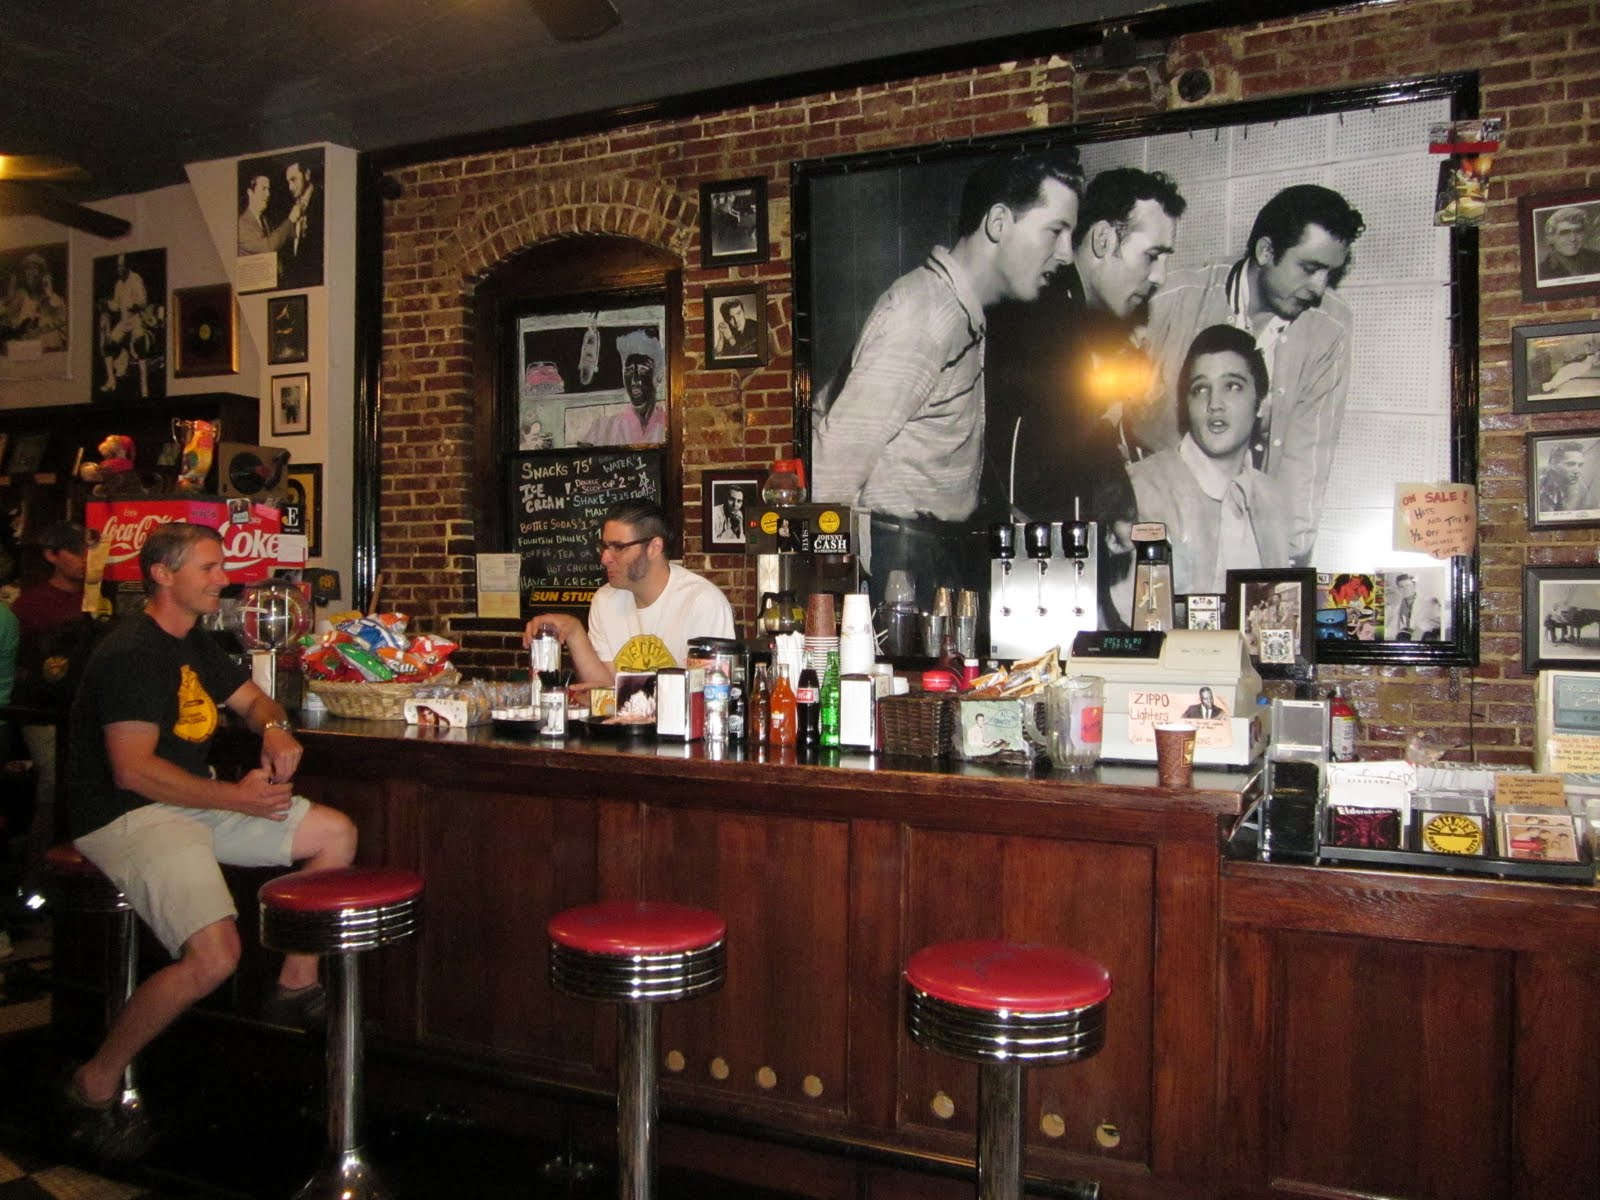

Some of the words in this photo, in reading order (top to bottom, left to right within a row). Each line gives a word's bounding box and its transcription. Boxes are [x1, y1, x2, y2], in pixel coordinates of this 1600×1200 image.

[521, 462, 568, 480] SNACKS
[603, 457, 634, 473] WATER
[519, 483, 546, 503] ICE
[1424, 491, 1457, 503] SALE
[526, 496, 565, 513] CREAM
[573, 494, 605, 507] SHAKE
[585, 508, 608, 518] MALT
[1414, 507, 1436, 520] HATS
[520, 521, 548, 533] BOTTLE
[550, 518, 578, 530] SODAS
[517, 537, 553, 546] FOUNTAIN
[556, 534, 588, 545] DRINKS
[813, 540, 847, 550] CASH
[557, 549, 575, 560] TEA
[520, 575, 547, 592] HAVE
[564, 577, 603, 587] GREAT
[532, 591, 560, 602] SUN
[1134, 692, 1170, 708] ZIPPO
[1130, 707, 1170, 726] Lighters
